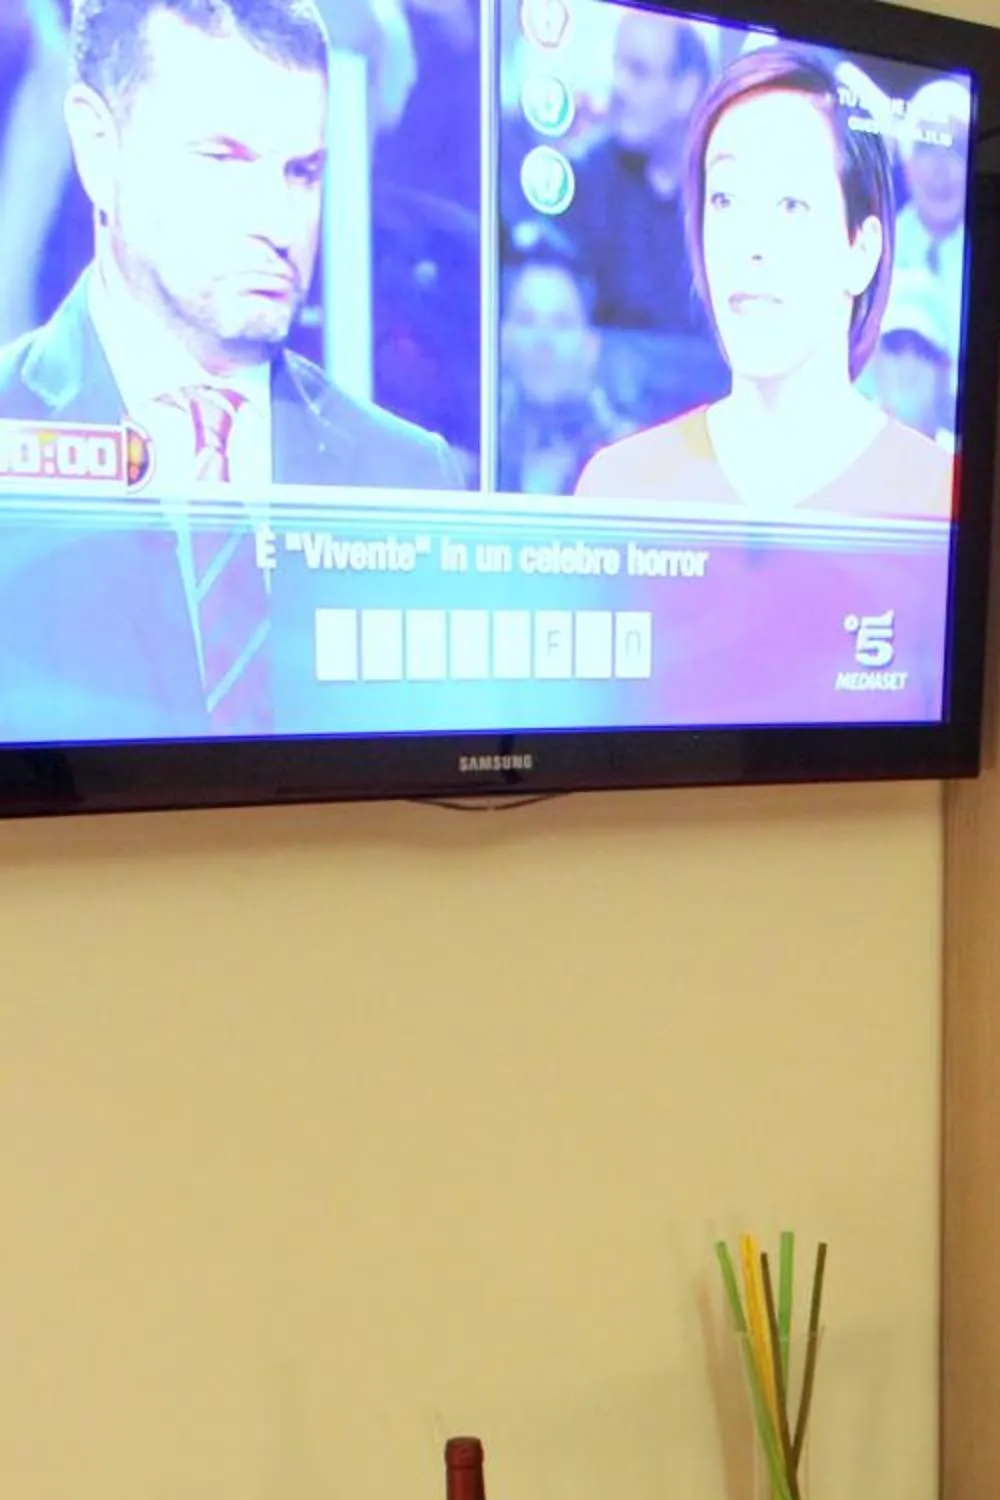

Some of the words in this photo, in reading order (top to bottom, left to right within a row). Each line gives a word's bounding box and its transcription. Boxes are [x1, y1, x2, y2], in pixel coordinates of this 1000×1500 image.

[440, 535, 467, 572] in
[475, 544, 512, 573] un
[519, 540, 621, 576] celebre
[627, 541, 710, 577] horror
[458, 754, 533, 772] SAMSUNG
